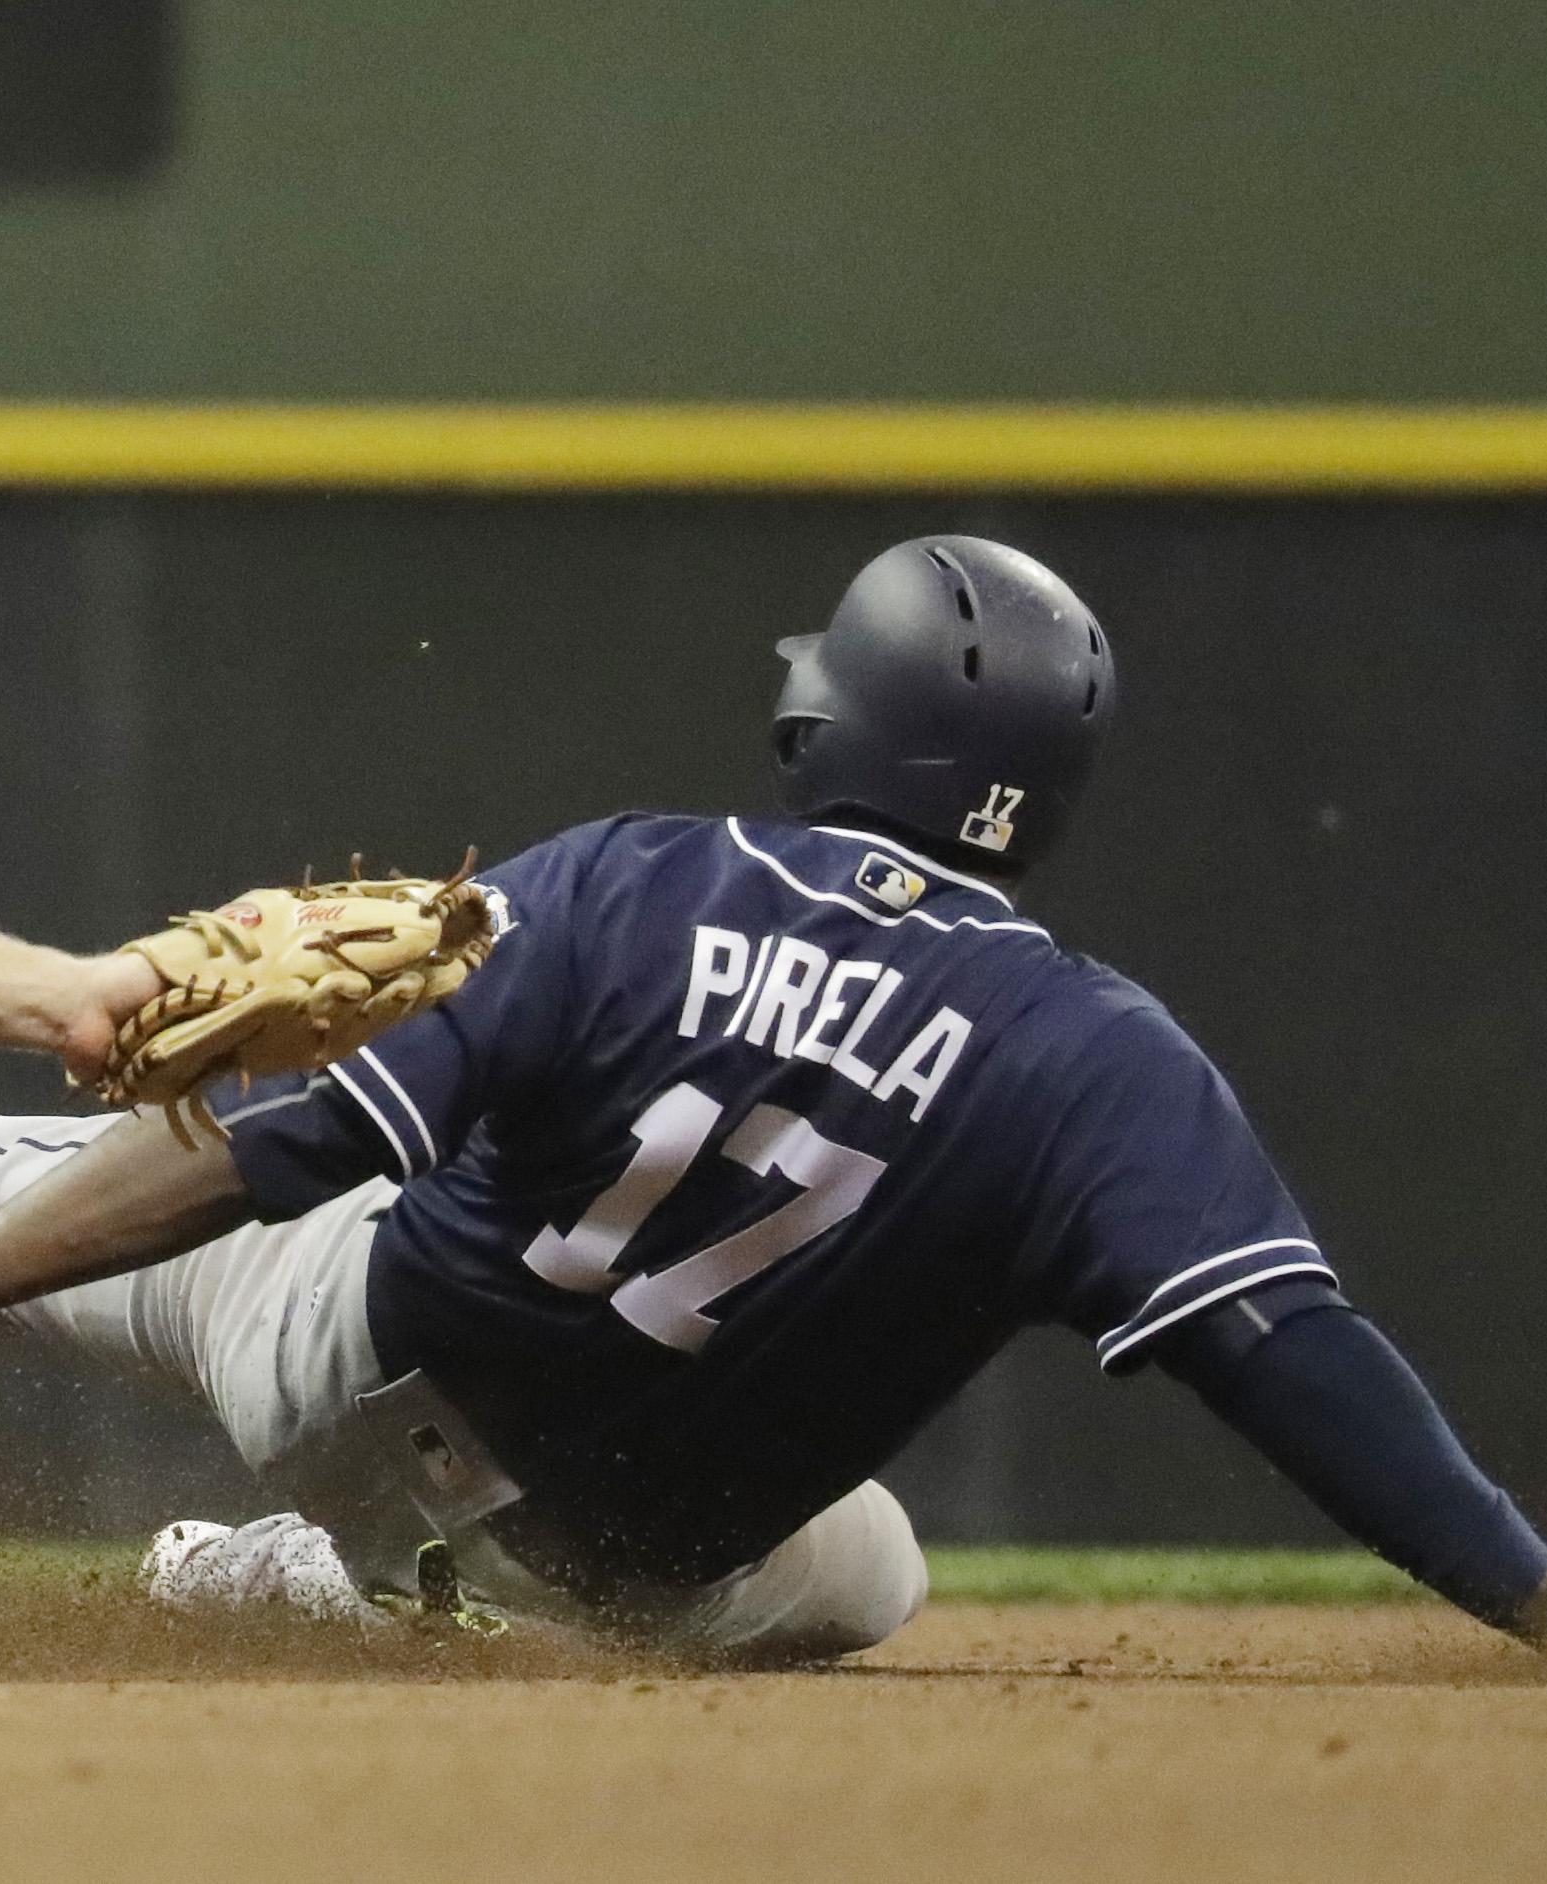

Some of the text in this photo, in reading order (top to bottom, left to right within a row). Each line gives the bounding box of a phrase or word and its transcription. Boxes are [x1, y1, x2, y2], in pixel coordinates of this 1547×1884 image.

[980, 783, 1025, 822] 17
[677, 924, 974, 1124] PIRELA
[521, 1080, 889, 1354] 17
